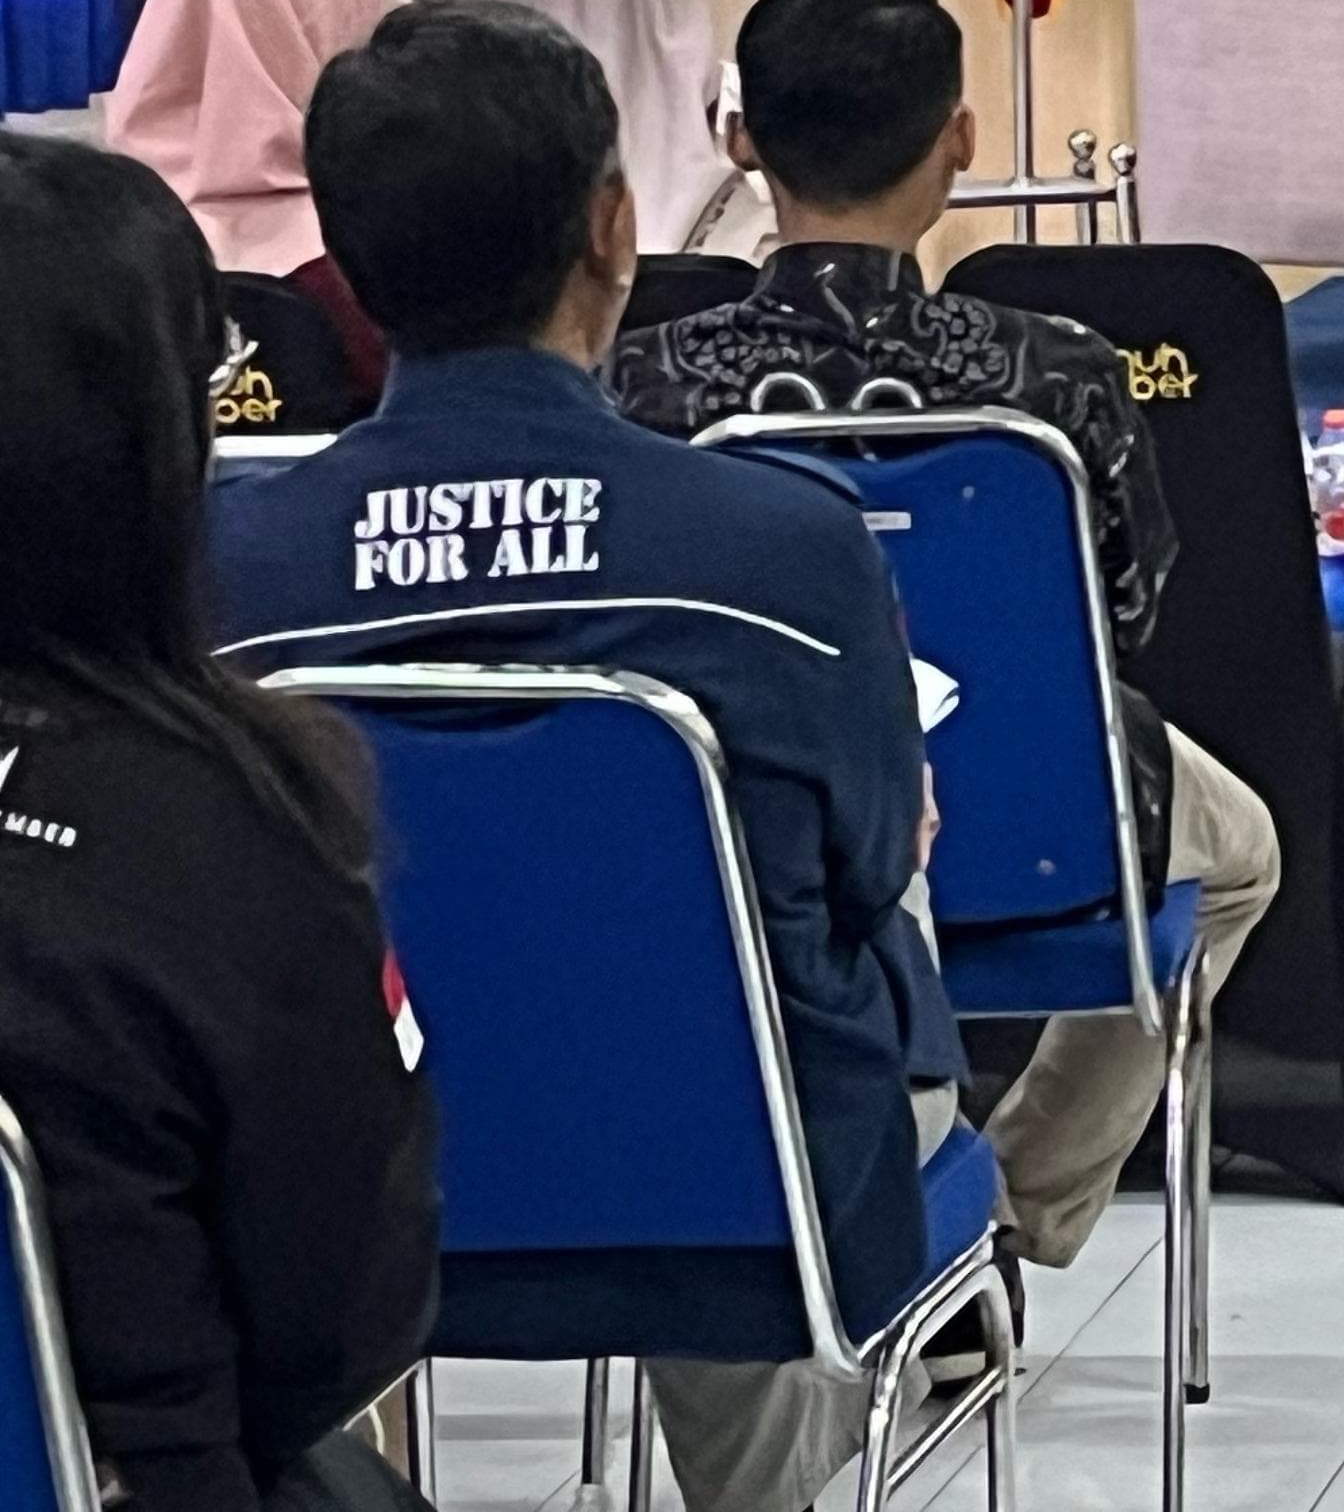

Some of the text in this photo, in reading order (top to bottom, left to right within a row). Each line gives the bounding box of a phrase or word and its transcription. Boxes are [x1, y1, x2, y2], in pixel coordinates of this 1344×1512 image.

[354, 478, 602, 539] JUSTICE
[354, 524, 599, 590] FOR ALL
